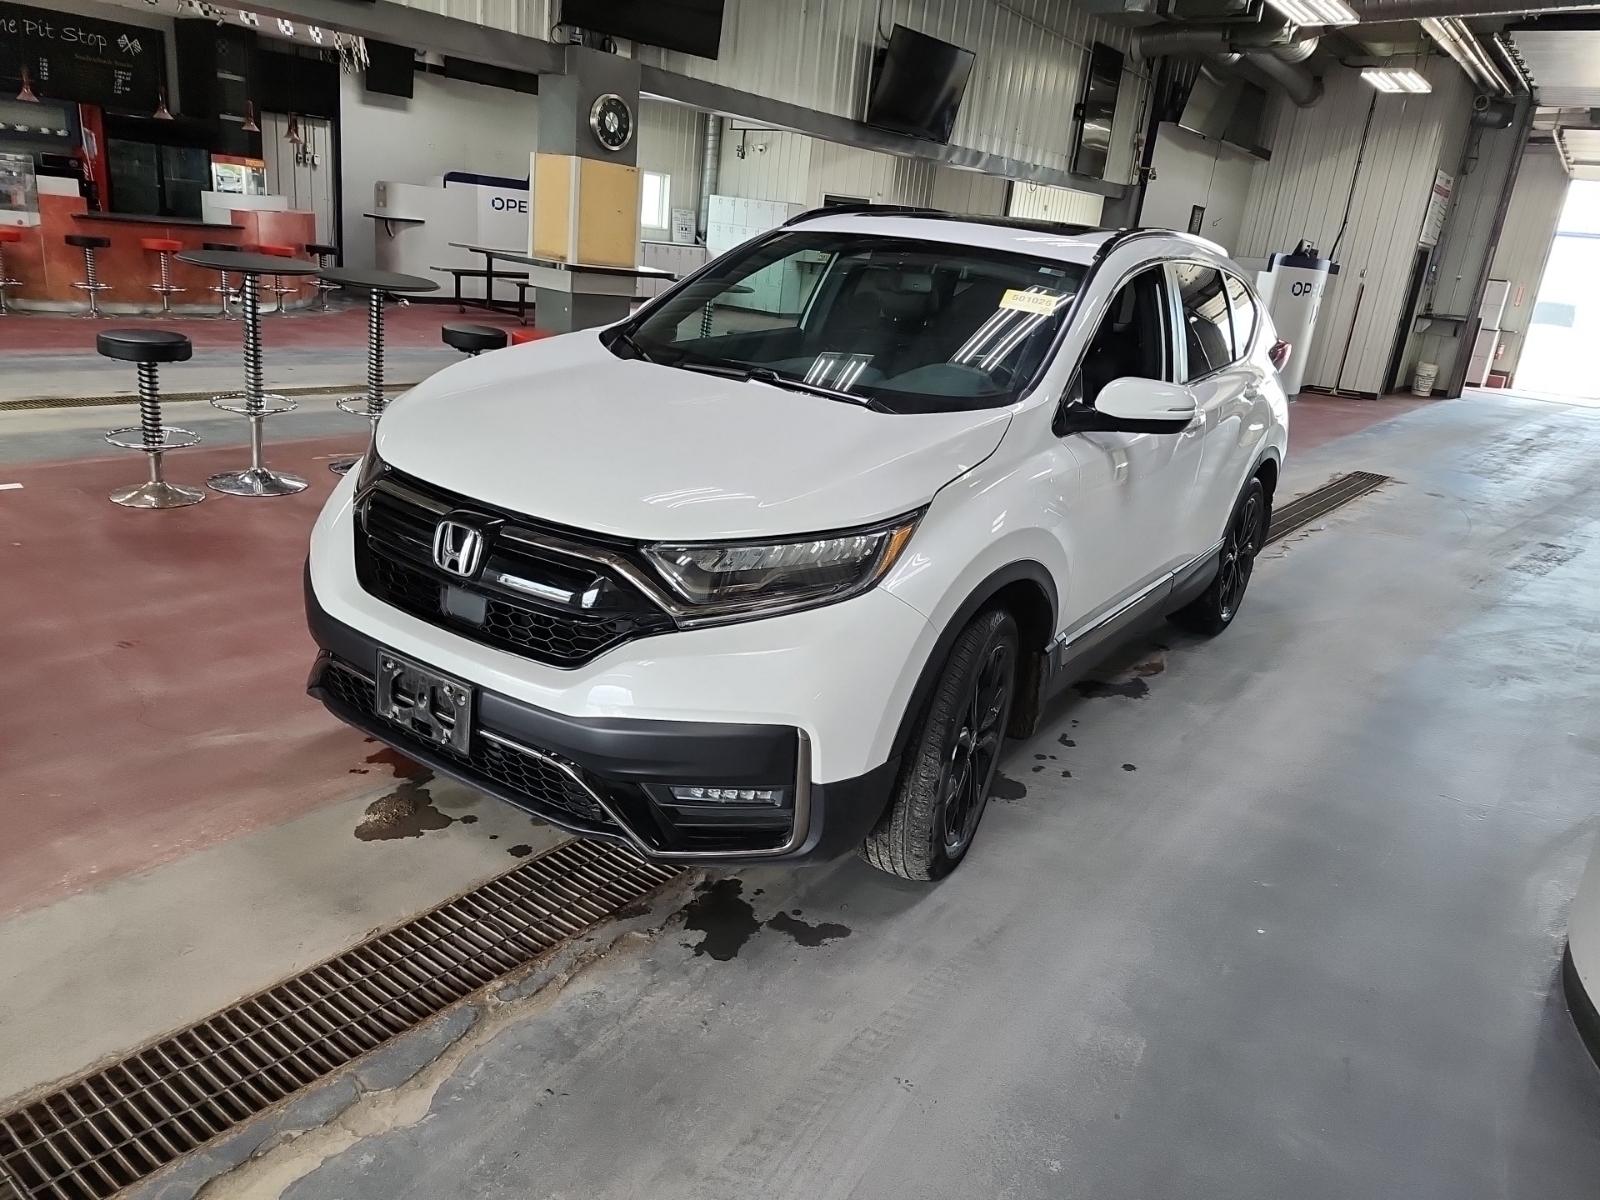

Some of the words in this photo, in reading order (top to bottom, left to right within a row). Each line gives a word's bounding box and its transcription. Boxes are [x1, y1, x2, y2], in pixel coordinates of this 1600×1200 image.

[22, 19, 55, 39] Pit
[60, 27, 107, 54] Stop
[1011, 294, 1053, 307] 501026
